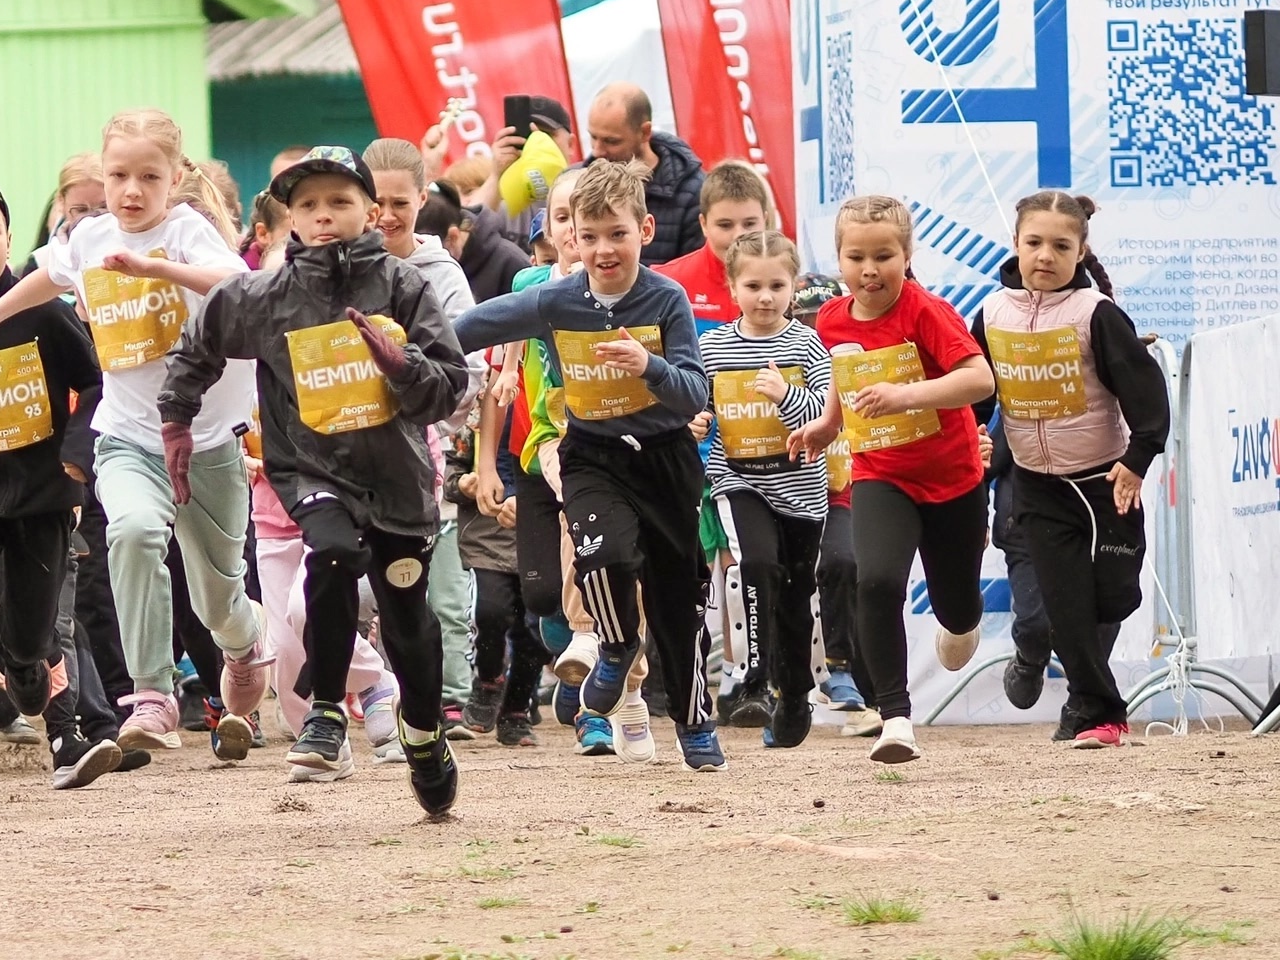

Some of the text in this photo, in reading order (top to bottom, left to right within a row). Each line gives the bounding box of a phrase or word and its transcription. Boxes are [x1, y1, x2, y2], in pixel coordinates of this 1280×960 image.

[1118, 238, 1277, 250] История предприятия
[1138, 256, 1192, 265] своими
[1196, 254, 1258, 266] корнями
[1260, 254, 1278, 263] во
[1165, 269, 1278, 281] времена, когда
[1180, 285, 1230, 297] консул
[89, 284, 180, 326] ЧЕМПИОН
[1205, 299, 1257, 311] Дитлев
[1260, 300, 1278, 310] по
[160, 310, 177, 327] 97
[640, 334, 657, 342] RUN
[1058, 335, 1074, 343] RUN
[20, 352, 37, 363] RUN
[898, 351, 915, 362] RUN
[1054, 348, 1068, 356] 500
[17, 366, 32, 376] 500
[896, 364, 911, 374] 500
[994, 359, 1081, 382] ЧЕМПИОН
[1060, 381, 1076, 395] 14
[601, 396, 630, 406] Павел
[1010, 398, 1059, 407] Константин
[24, 403, 42, 419] 93
[340, 401, 380, 416] Георгий
[870, 424, 897, 436] Дарья
[741, 435, 781, 445] Кристина
